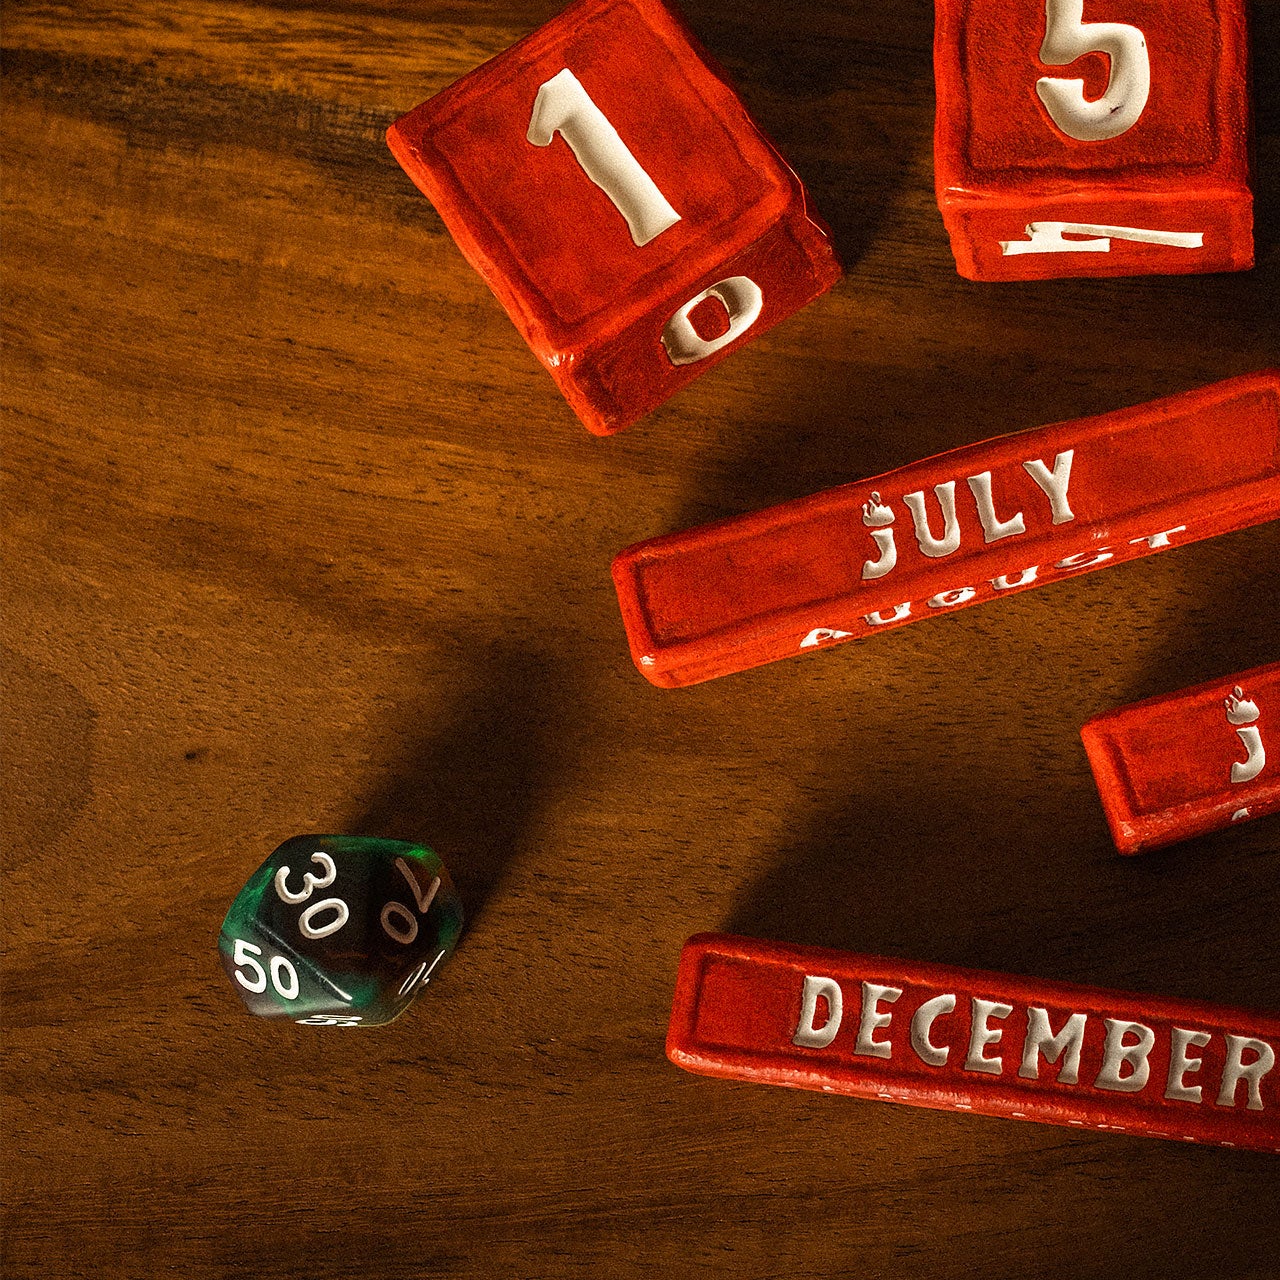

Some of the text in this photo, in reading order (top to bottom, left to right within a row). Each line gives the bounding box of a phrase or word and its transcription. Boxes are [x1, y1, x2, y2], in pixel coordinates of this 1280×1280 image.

[526, 68, 682, 248] 1
[661, 275, 763, 366] 0
[861, 448, 1075, 580] JULY
[800, 525, 1186, 648] AUGUST
[274, 852, 350, 939] 30
[380, 857, 441, 944] 70
[234, 938, 299, 1000] 50
[792, 974, 1276, 1111] DECEMBER
